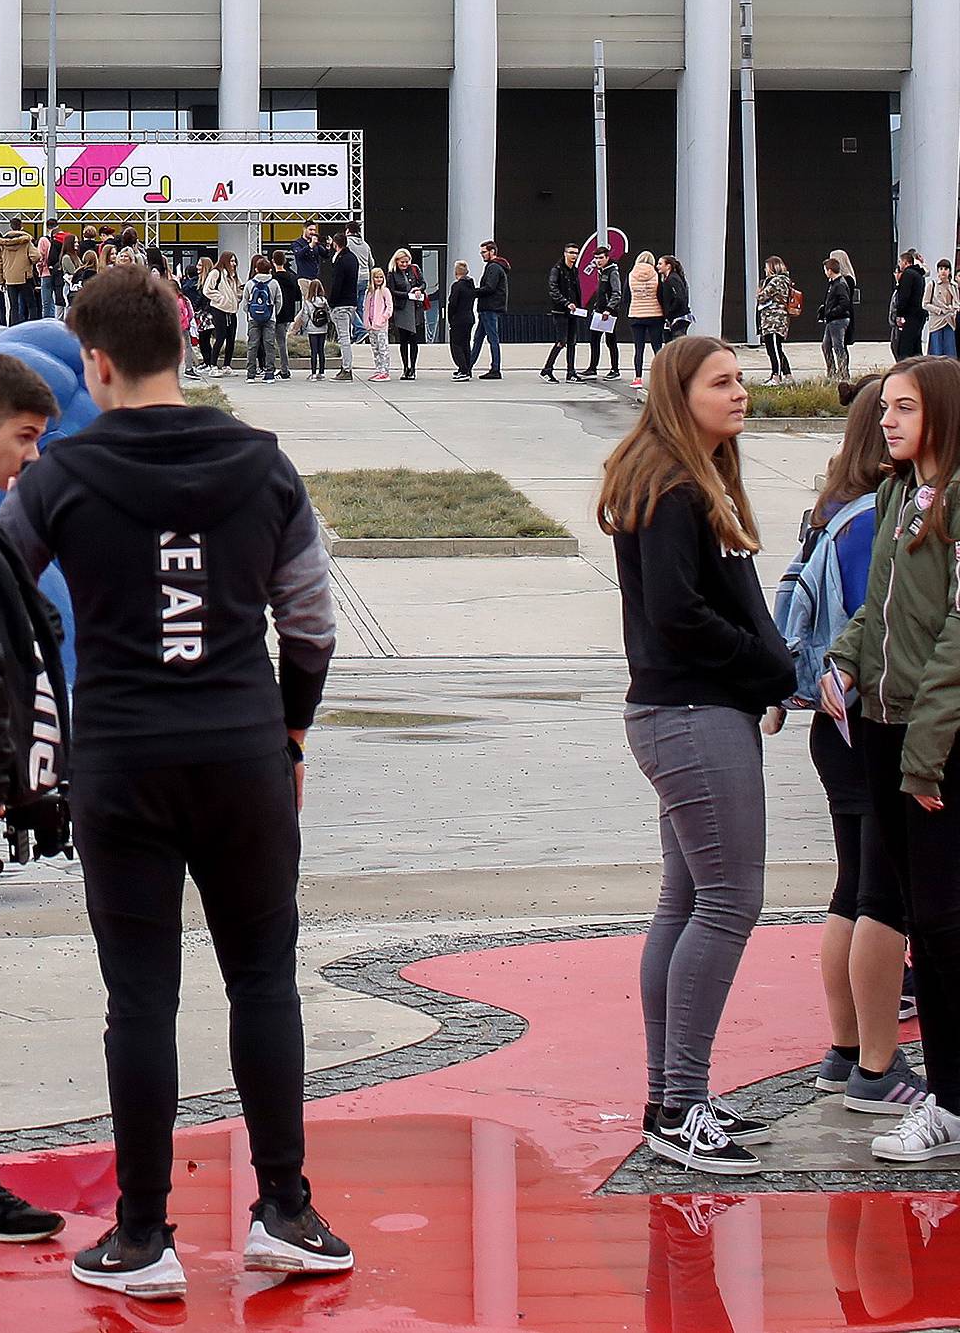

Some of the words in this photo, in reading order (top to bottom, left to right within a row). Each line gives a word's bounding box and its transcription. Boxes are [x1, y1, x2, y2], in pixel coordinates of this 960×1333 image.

[252, 163, 339, 177] BUSINESS
[212, 180, 234, 202] A1
[280, 182, 311, 195] VIP
[161, 584, 203, 663] AIR
